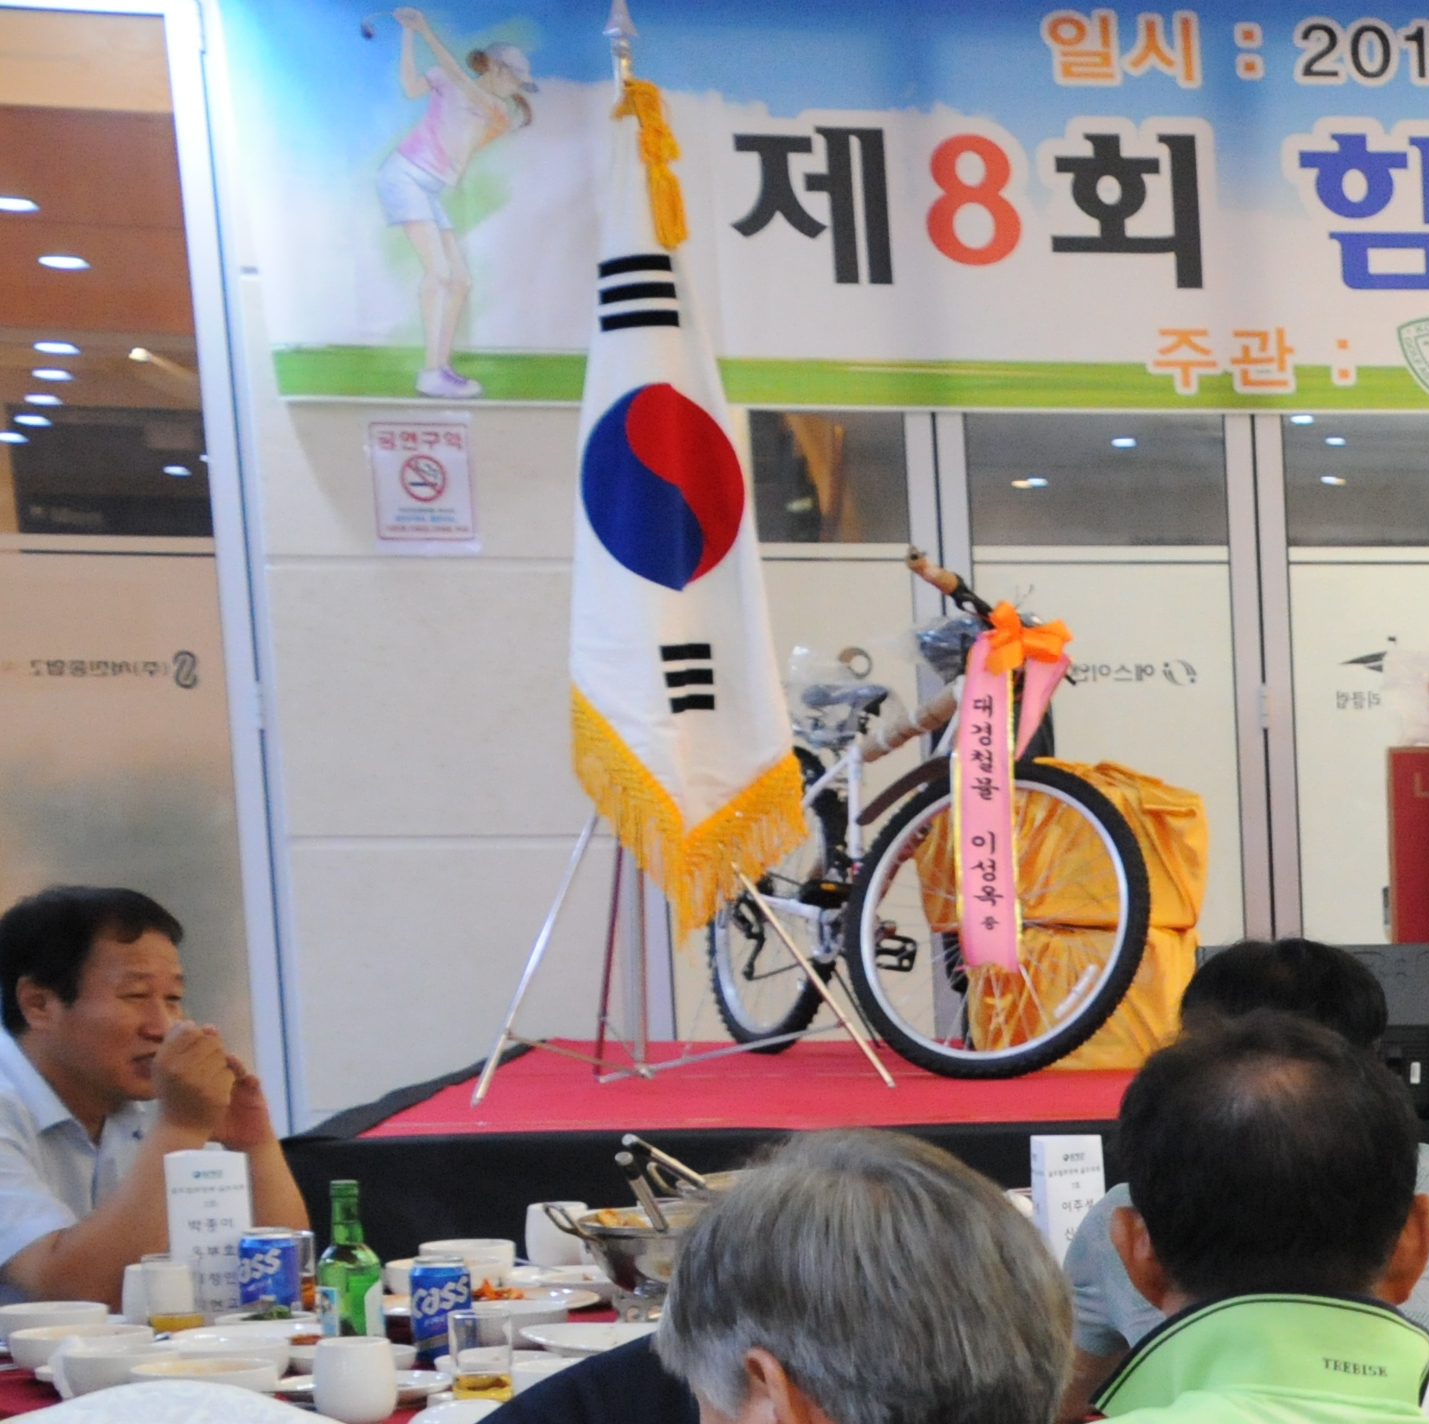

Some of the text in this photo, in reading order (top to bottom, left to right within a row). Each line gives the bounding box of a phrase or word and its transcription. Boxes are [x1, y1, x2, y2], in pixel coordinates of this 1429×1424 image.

[1046, 13, 1198, 84] 일시
[731, 126, 1205, 290] 제8회
[1152, 326, 1296, 388] 주관
[238, 1247, 282, 1284] ass
